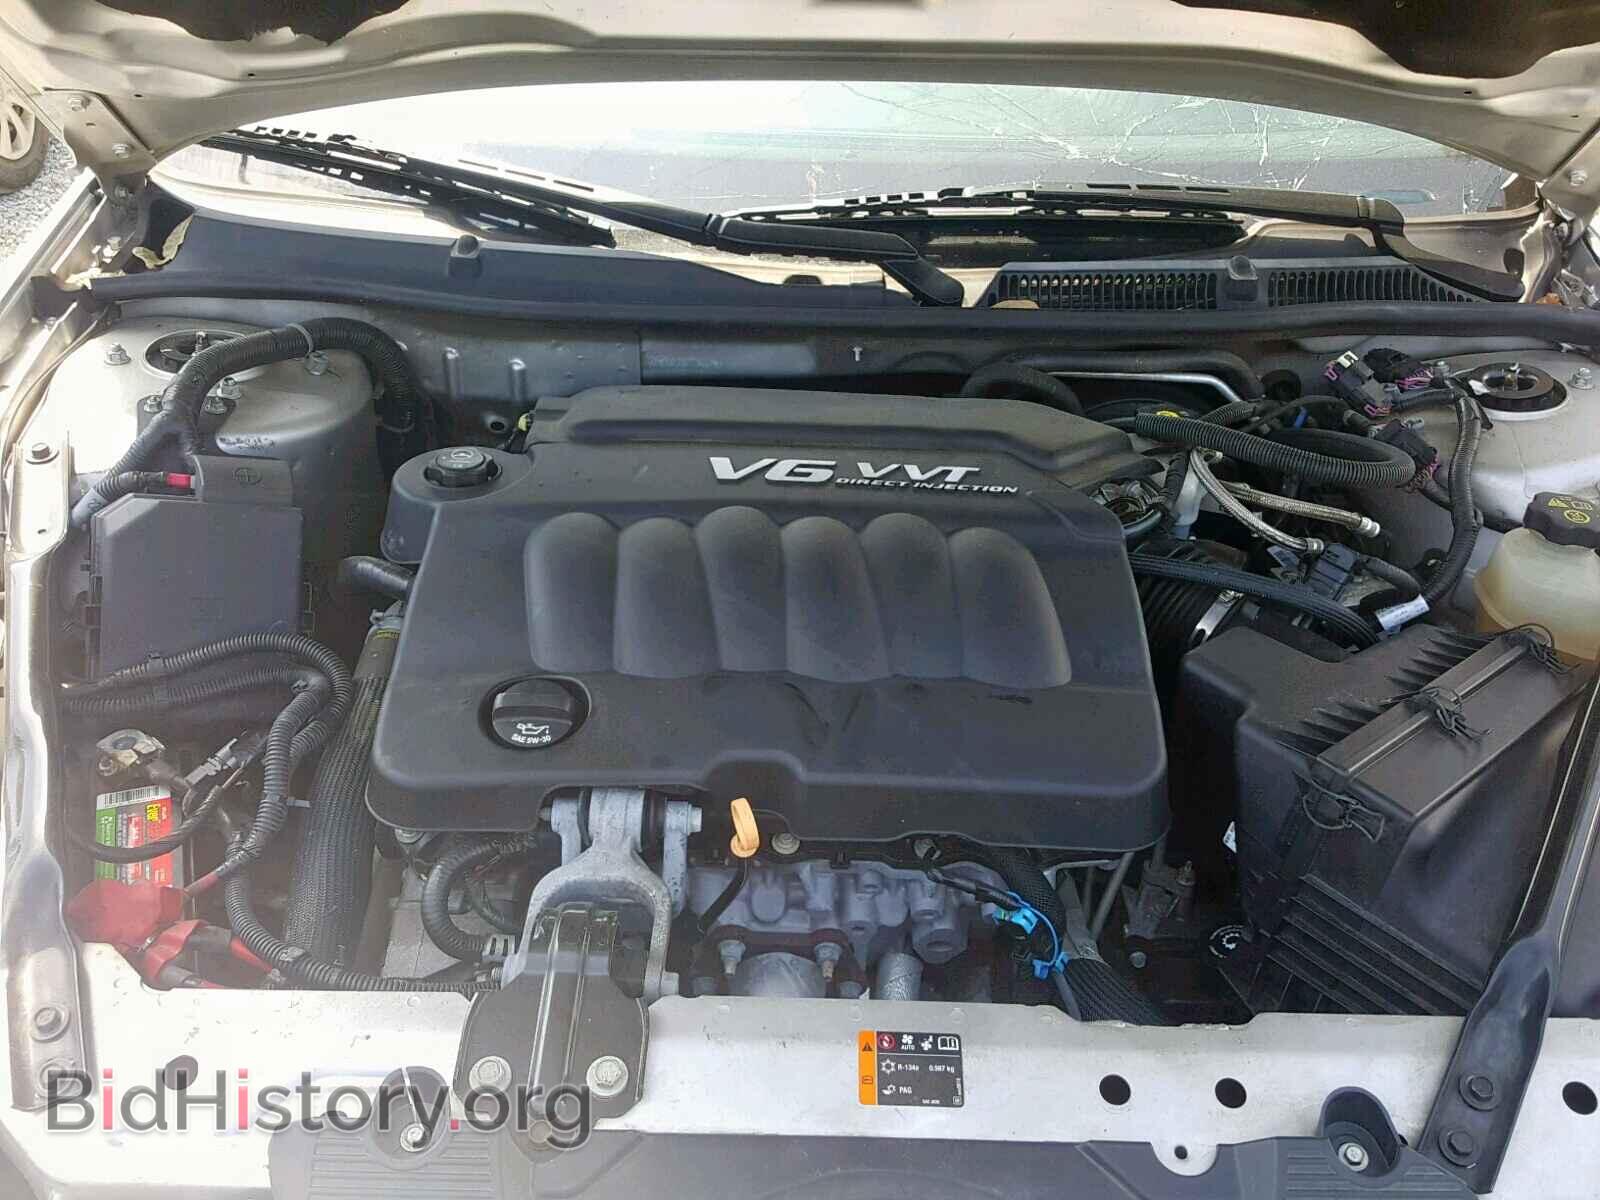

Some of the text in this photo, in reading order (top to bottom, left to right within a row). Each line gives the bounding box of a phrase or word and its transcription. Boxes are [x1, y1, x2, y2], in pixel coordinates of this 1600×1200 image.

[709, 456, 980, 483] V6 VVT
[835, 478, 1018, 494] DIRECT INJECTION
[898, 1086, 912, 1094] PAG
